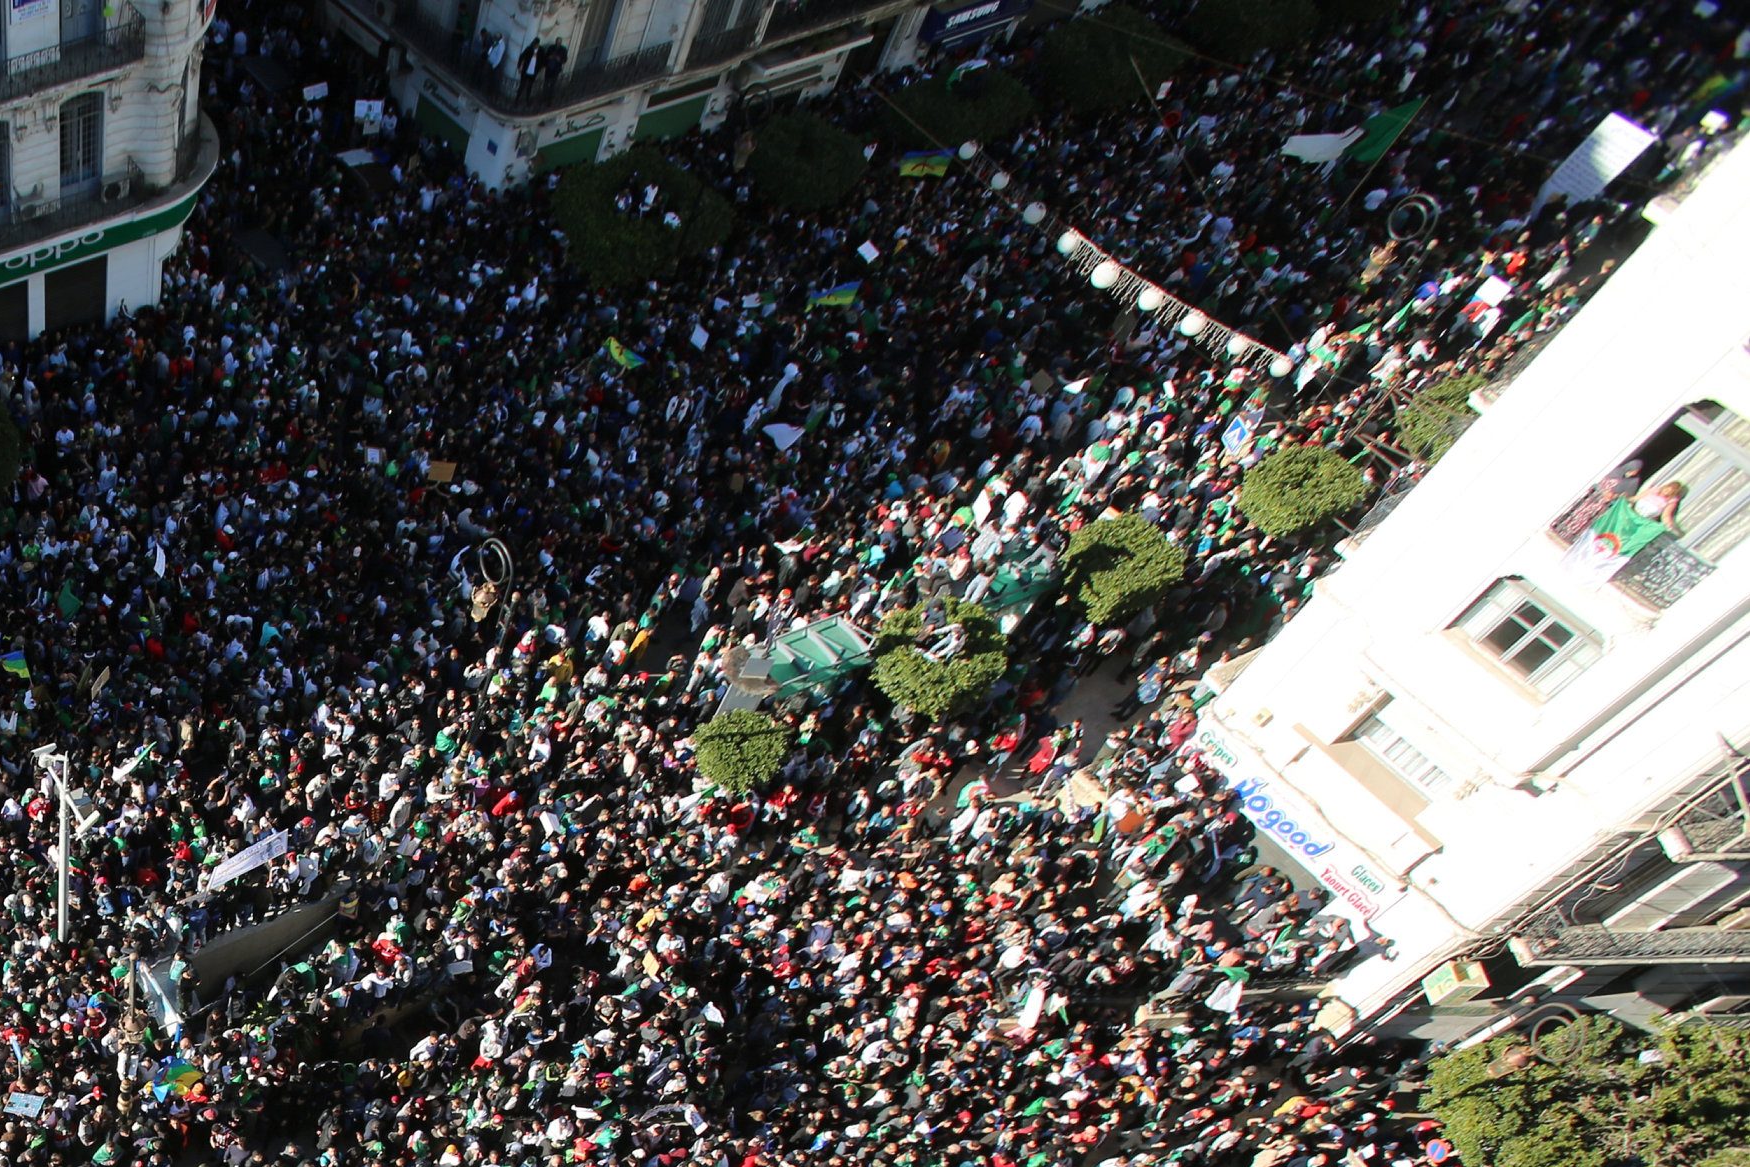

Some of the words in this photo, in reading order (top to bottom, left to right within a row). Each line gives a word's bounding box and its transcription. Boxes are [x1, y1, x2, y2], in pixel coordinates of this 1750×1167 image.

[945, 0, 1001, 29] SAMSUNG
[1319, 867, 1349, 897] Yaourt
[1346, 889, 1373, 917] Glacé
[1351, 865, 1382, 894] Glaces
